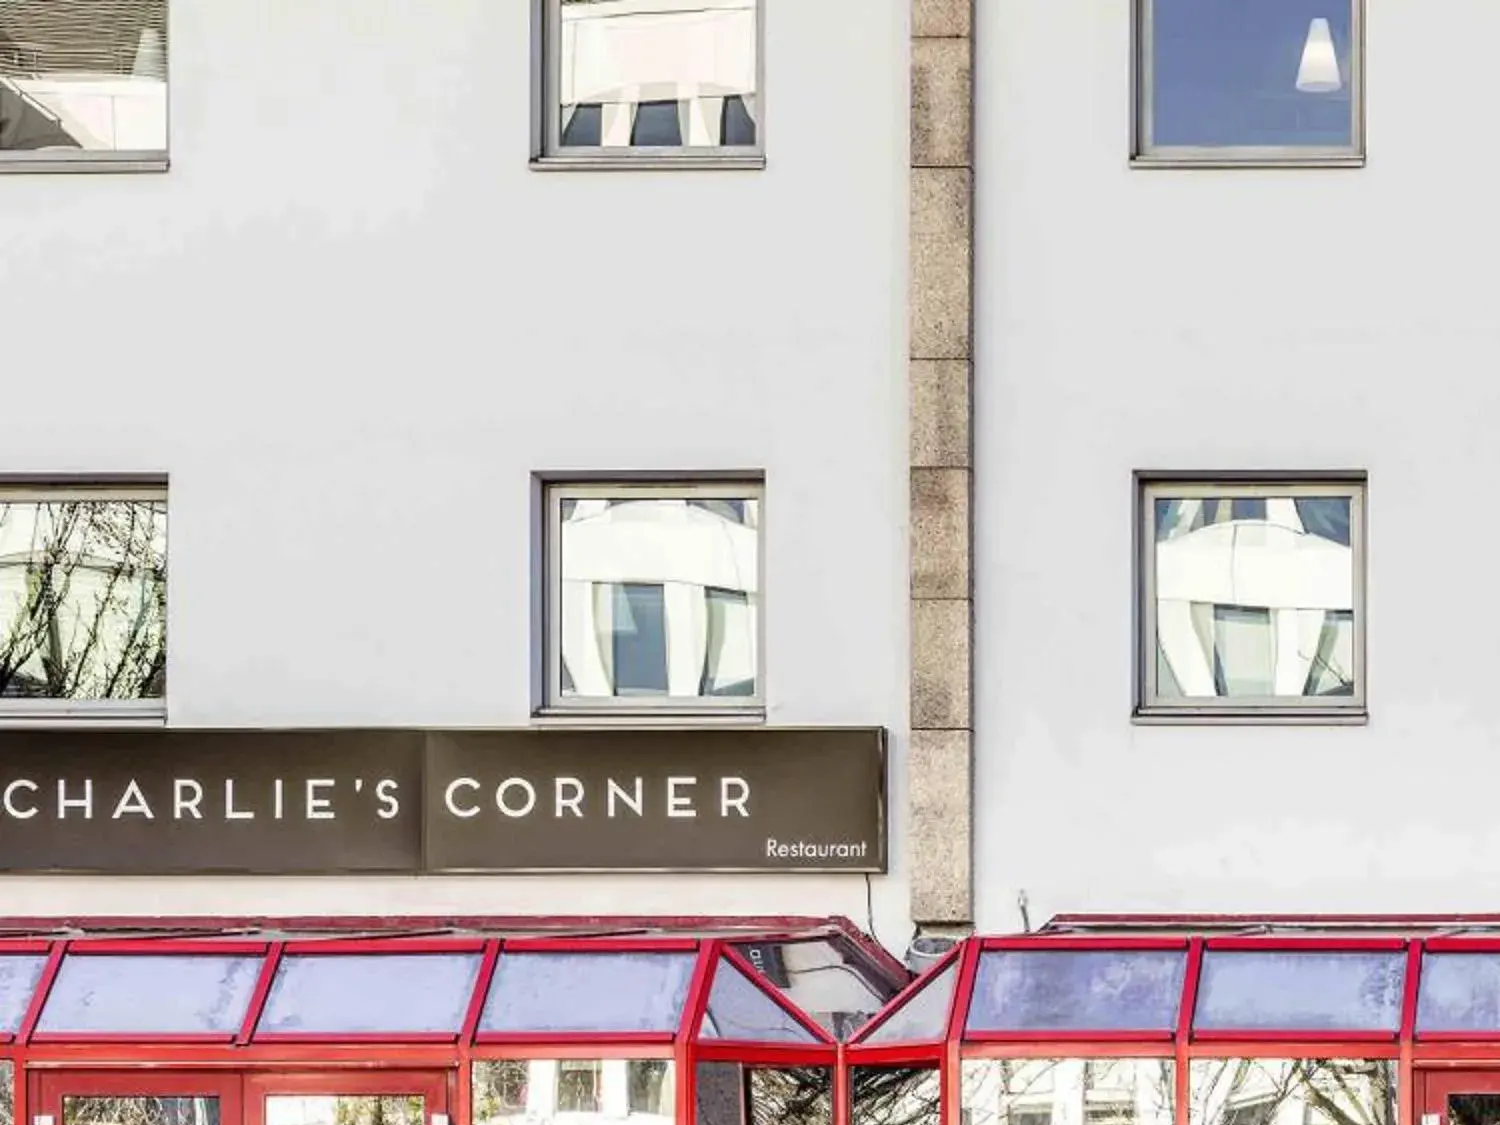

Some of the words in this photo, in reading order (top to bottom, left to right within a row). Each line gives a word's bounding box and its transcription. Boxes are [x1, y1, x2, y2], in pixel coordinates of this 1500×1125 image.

[3, 778, 400, 819] CHARLIE'S
[444, 776, 751, 818] CORNER
[765, 837, 867, 858] Restaurant
